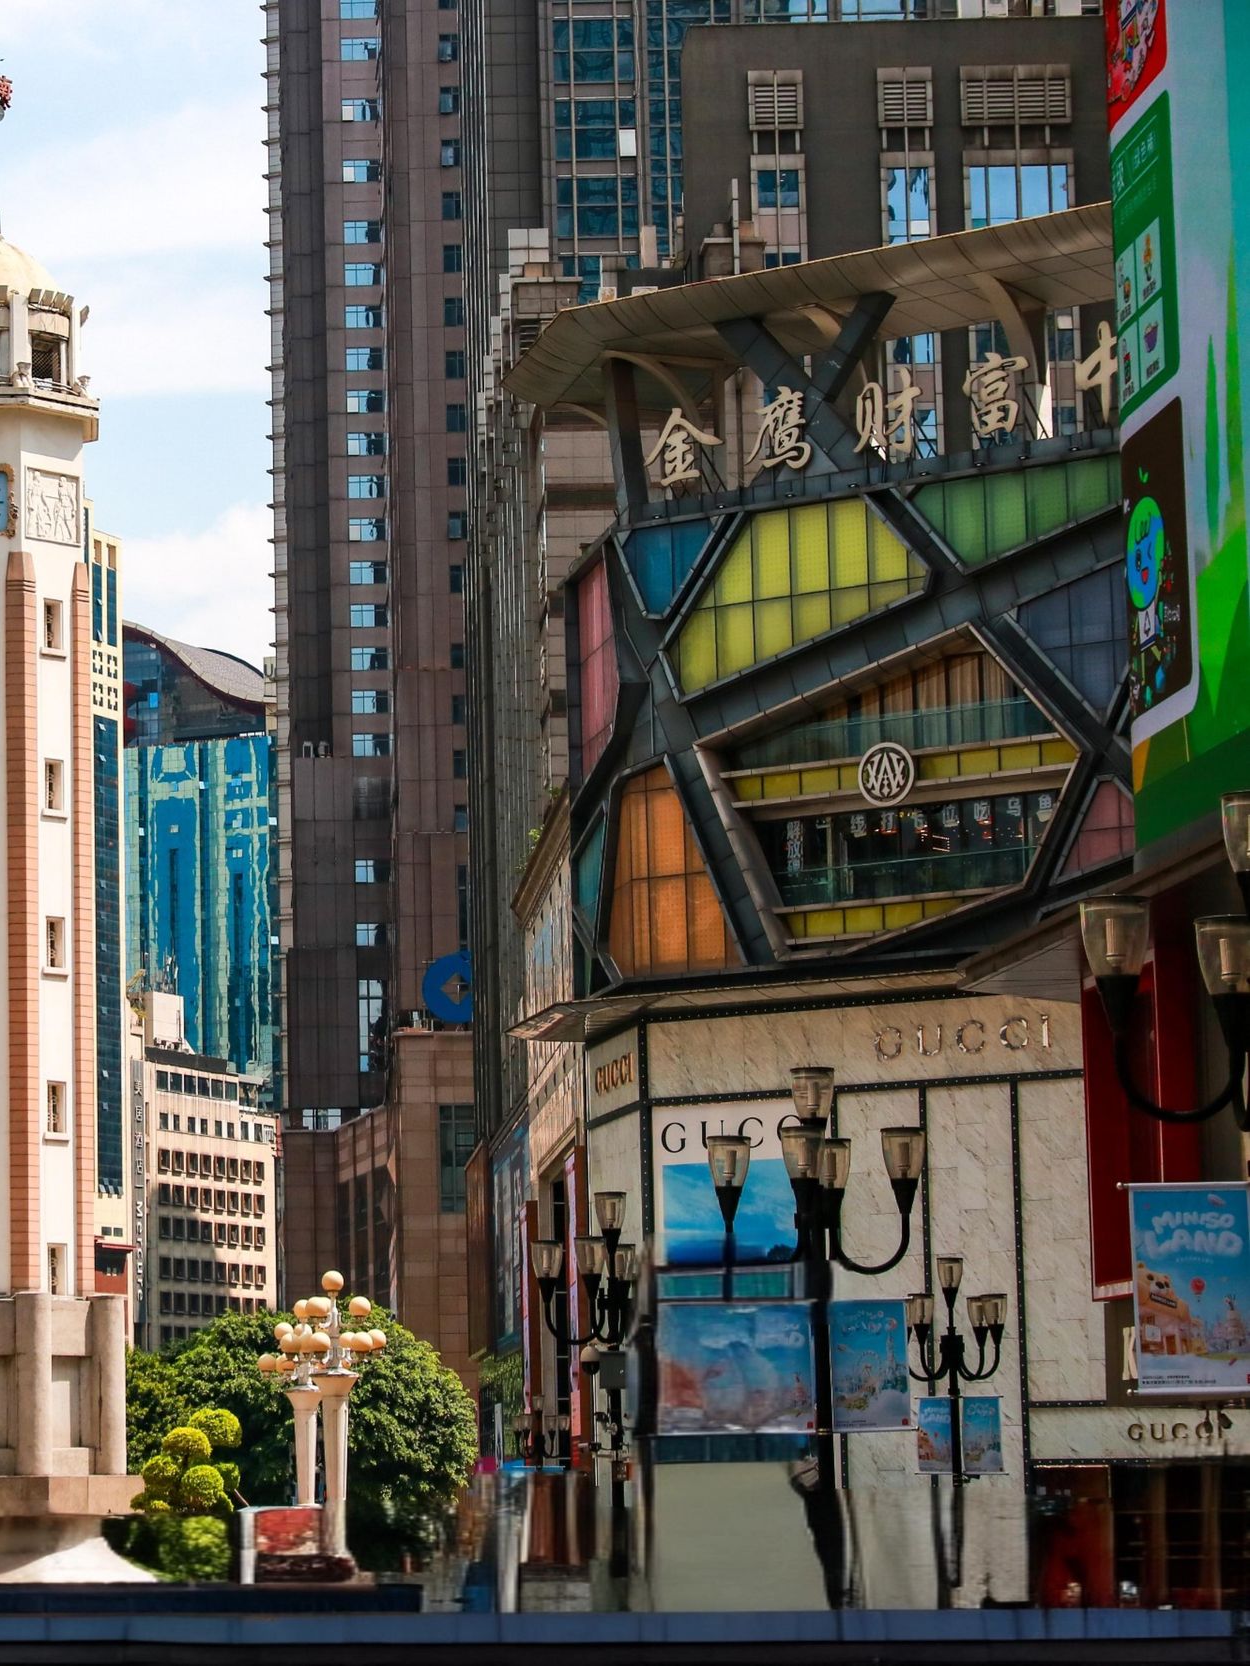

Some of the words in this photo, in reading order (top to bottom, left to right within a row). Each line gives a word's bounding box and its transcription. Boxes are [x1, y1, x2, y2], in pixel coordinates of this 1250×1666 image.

[874, 1015, 1050, 1061] GUCCI
[595, 1052, 633, 1096] GUCCI
[1144, 1229, 1243, 1259] LAND
[1152, 1211, 1235, 1234] MINISO
[136, 1201, 144, 1302] Mercure
